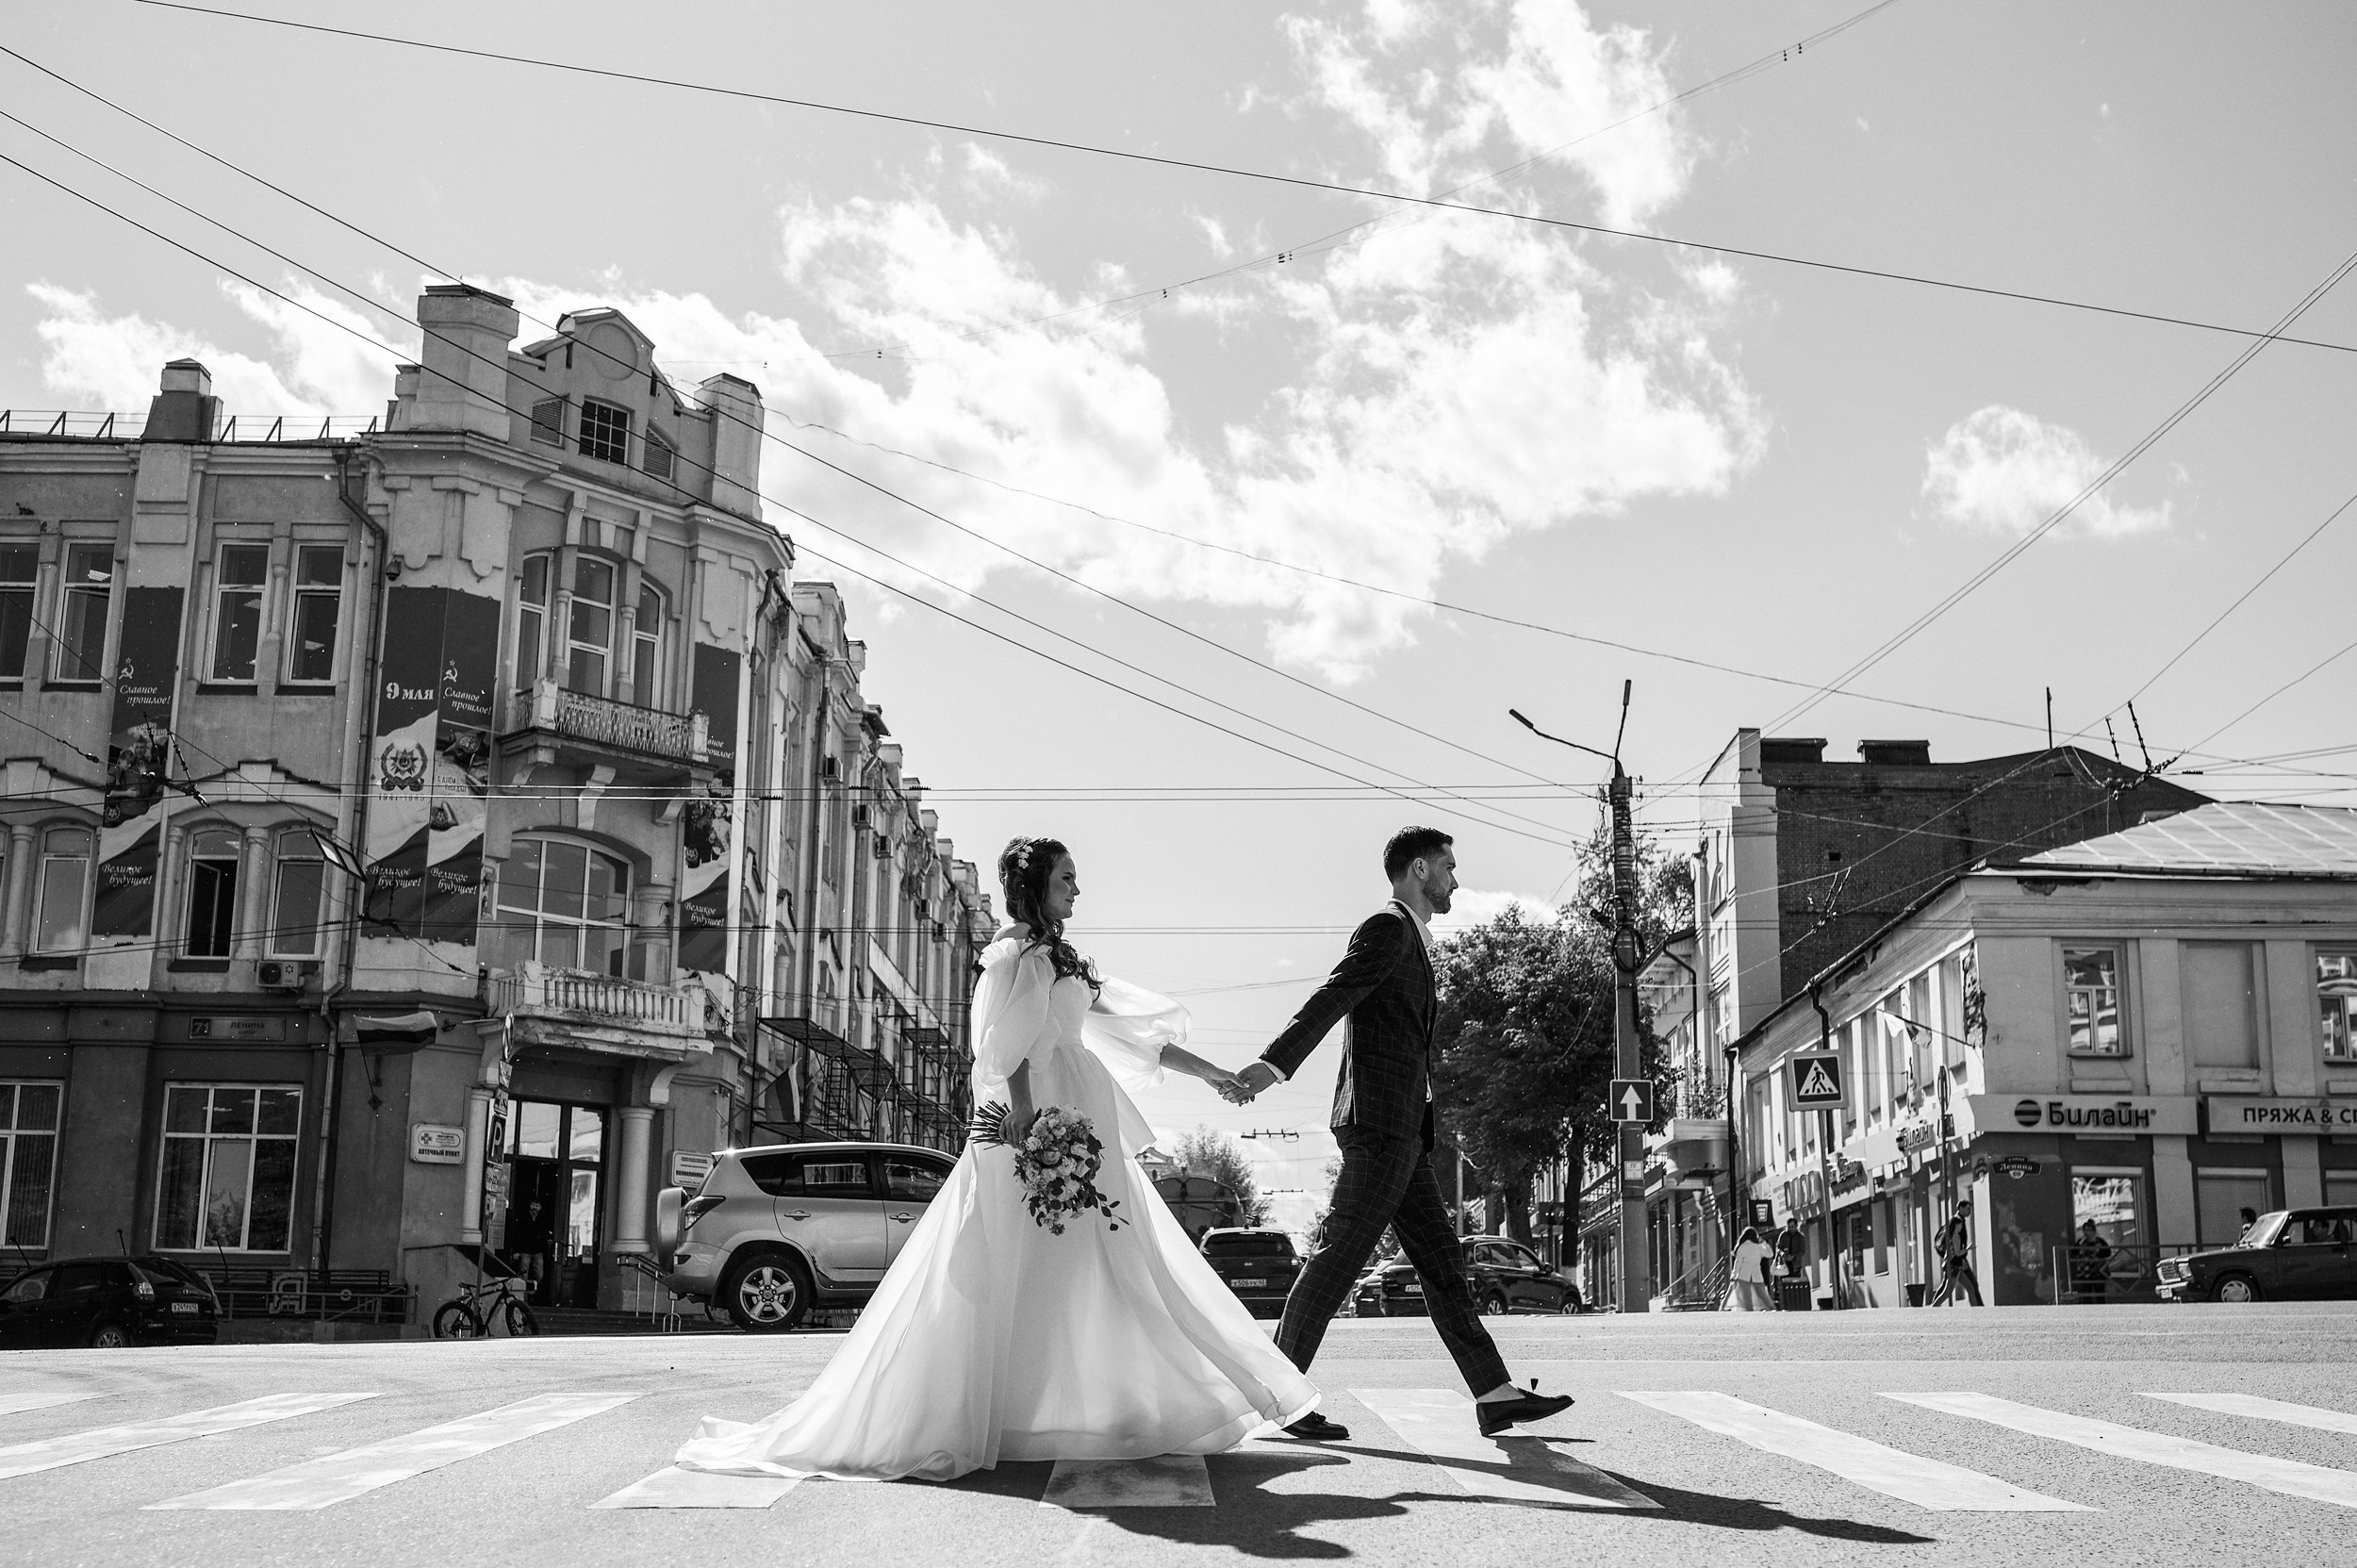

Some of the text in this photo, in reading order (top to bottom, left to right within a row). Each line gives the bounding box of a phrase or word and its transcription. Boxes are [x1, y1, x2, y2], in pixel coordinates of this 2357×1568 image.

[119, 684, 158, 695] Славное
[386, 682, 435, 701] 9 МАЯ
[444, 686, 480, 702] Славное
[126, 695, 172, 707] прошлое!
[452, 701, 492, 715] прошлое!
[102, 863, 142, 875] Великое
[430, 867, 469, 883] Великое
[108, 874, 153, 887] будущее!
[437, 878, 478, 895] будущее!
[684, 901, 717, 916] Великое
[690, 912, 724, 927] будущее!
[230, 1020, 265, 1030] ЛЕНИНА
[2048, 1101, 2150, 1128] Билайн
[2243, 1107, 2316, 1124] ПРЯЖА
[2320, 1108, 2333, 1124] &
[1999, 1163, 2033, 1172] Ленина
